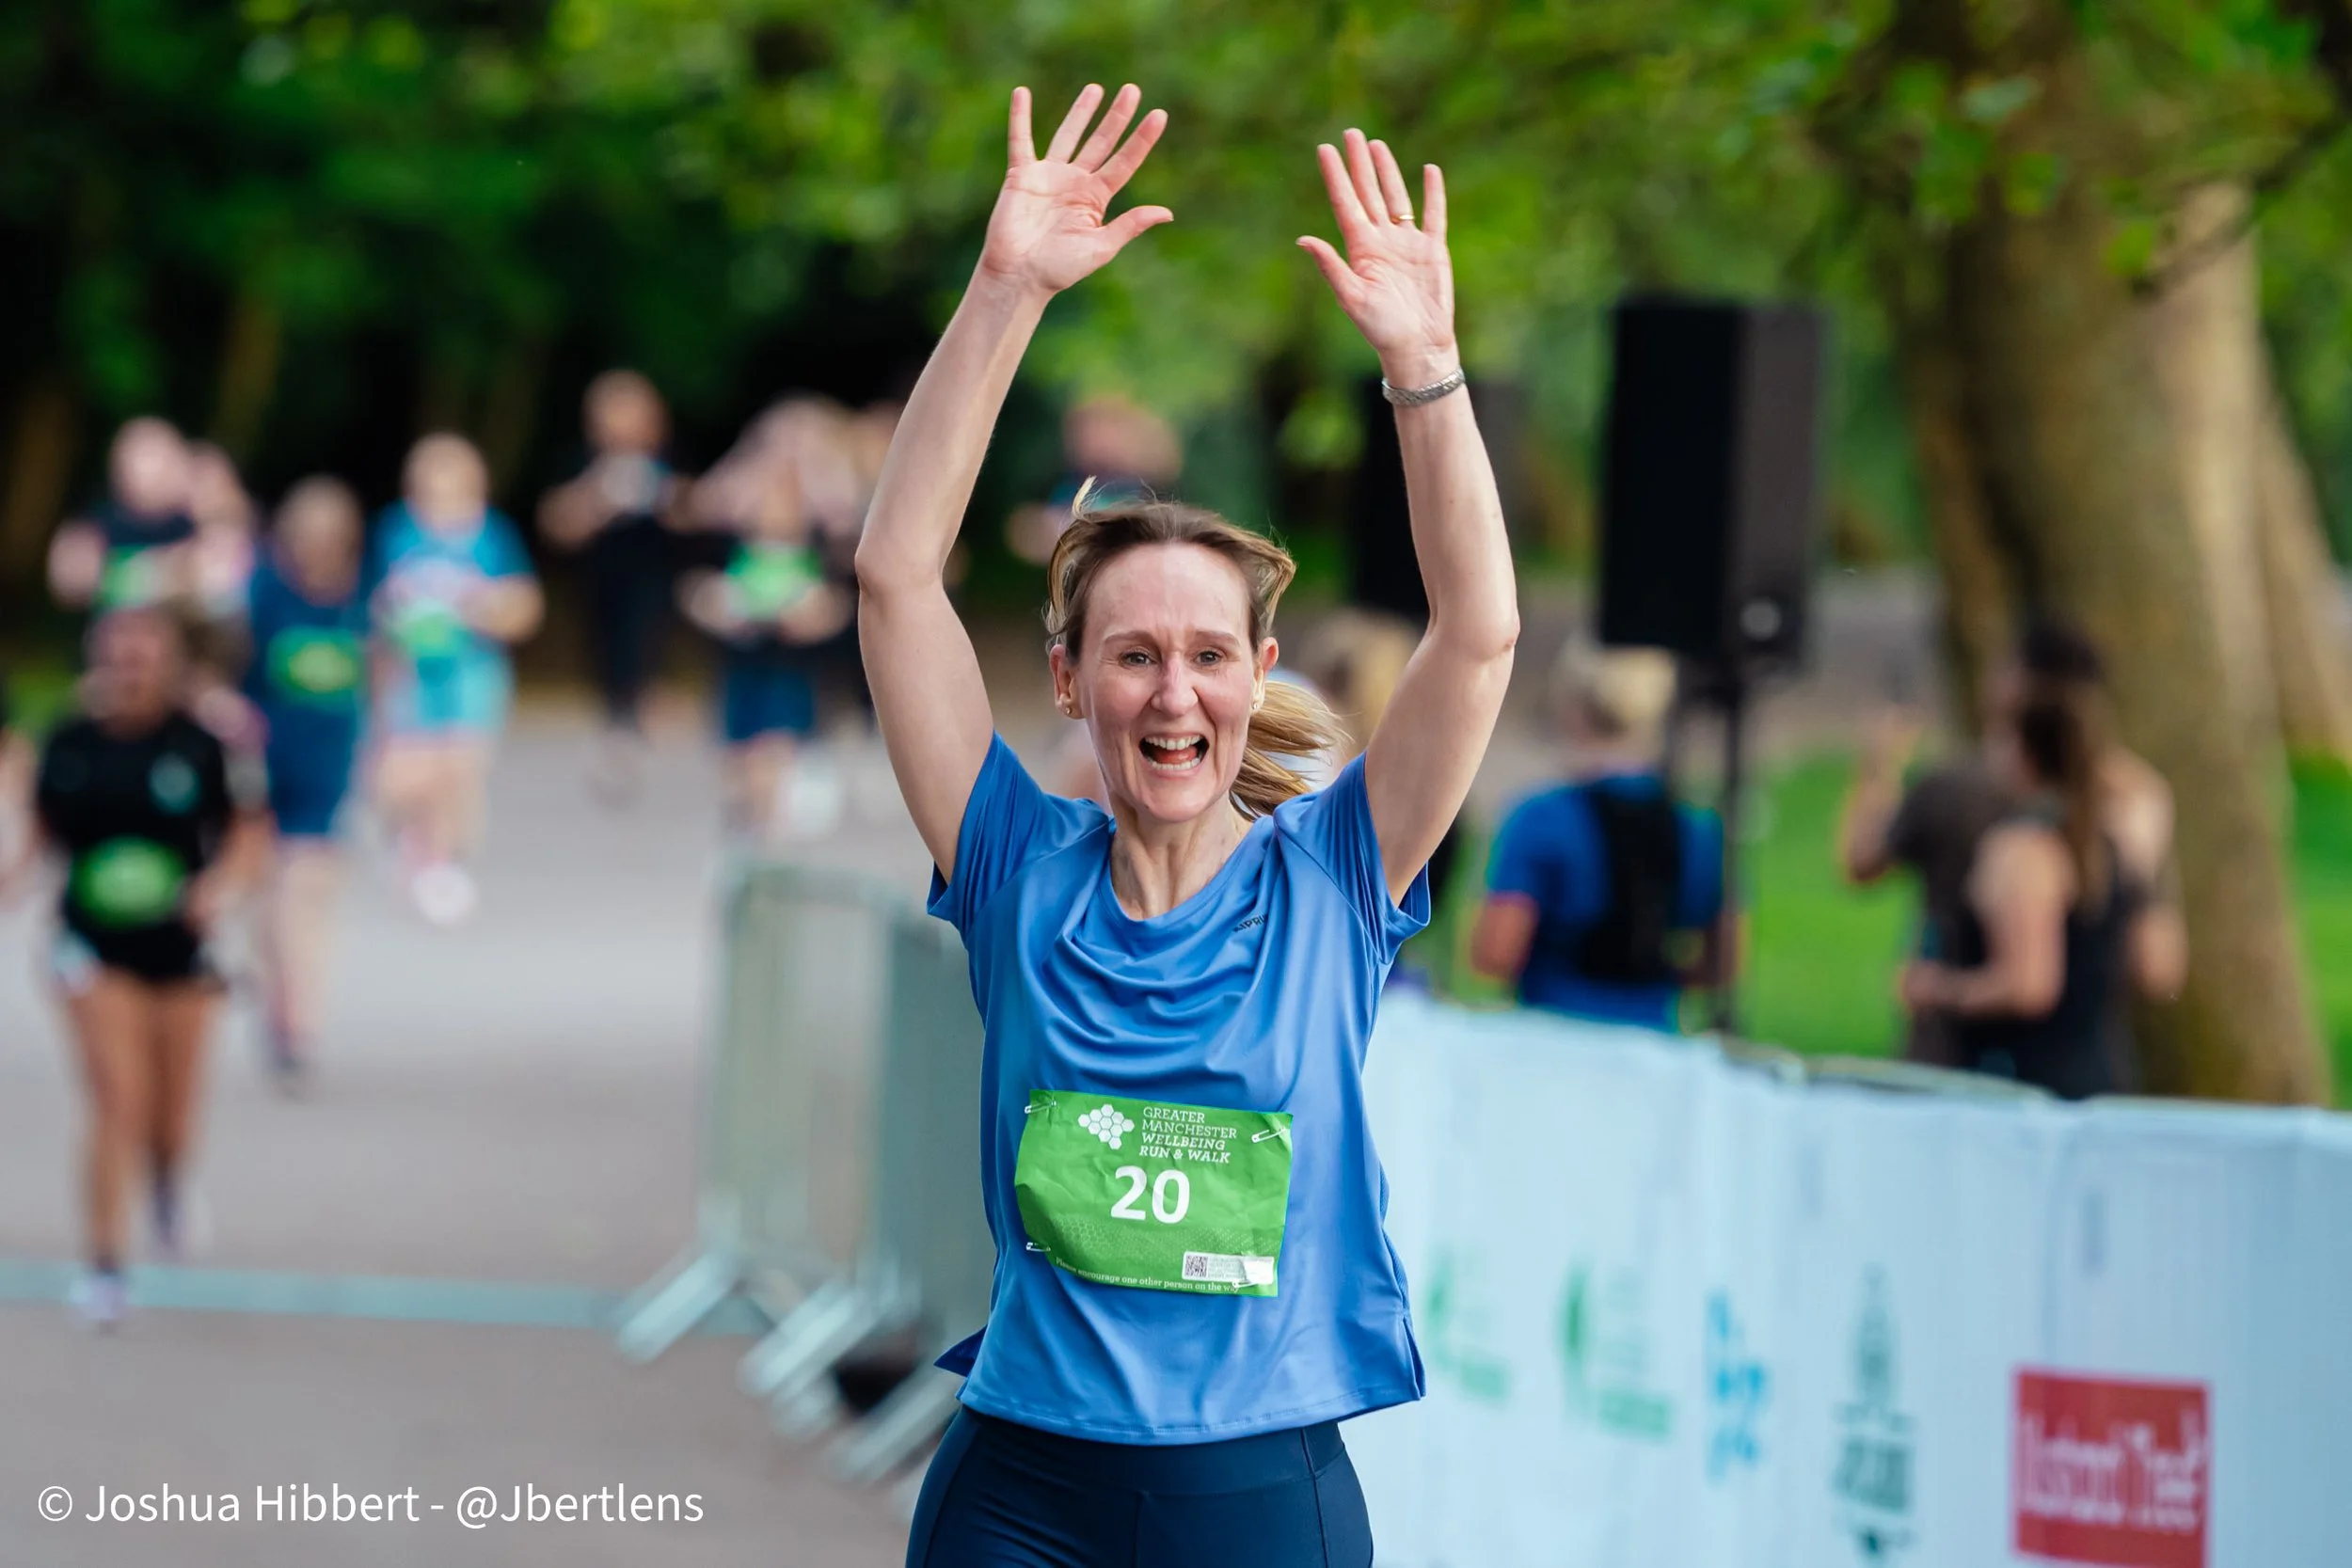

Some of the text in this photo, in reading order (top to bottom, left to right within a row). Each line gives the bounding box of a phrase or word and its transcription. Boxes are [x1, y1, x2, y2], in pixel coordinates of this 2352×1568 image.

[1143, 1106, 1205, 1123] GREATER
[1142, 1119, 1237, 1139] MANCHESTER
[1142, 1132, 1226, 1150] WELLBEING
[1139, 1145, 1231, 1164] RUN & WALK
[1110, 1164, 1190, 1224] 20
[1077, 1269, 1120, 1284] encourage
[1121, 1275, 1137, 1285] one
[1138, 1275, 1162, 1287] other
[1163, 1280, 1193, 1290] person
[1208, 1282, 1222, 1291] the
